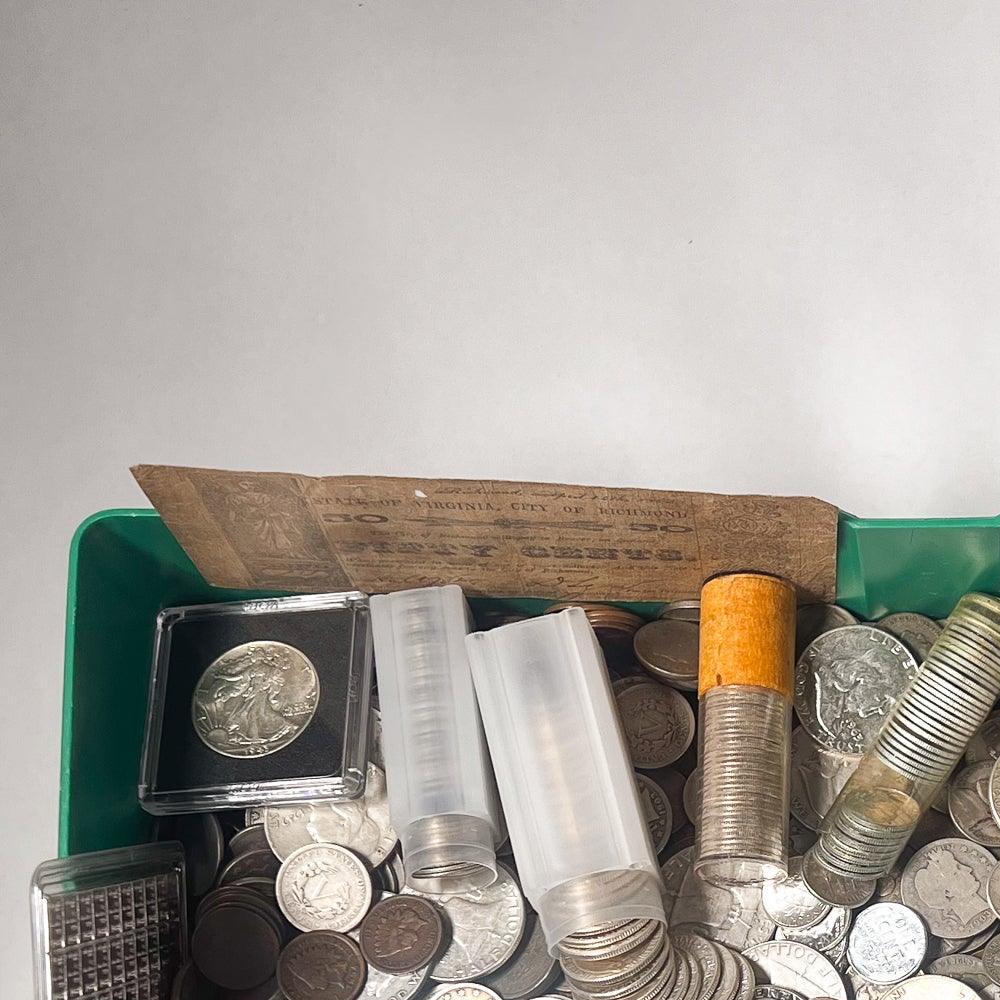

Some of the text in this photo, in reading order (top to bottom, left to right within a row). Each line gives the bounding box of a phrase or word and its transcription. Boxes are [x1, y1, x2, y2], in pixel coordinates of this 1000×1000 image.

[510, 502, 549, 513] CITY
[563, 506, 585, 515] OF
[600, 506, 689, 519] RICHMOND
